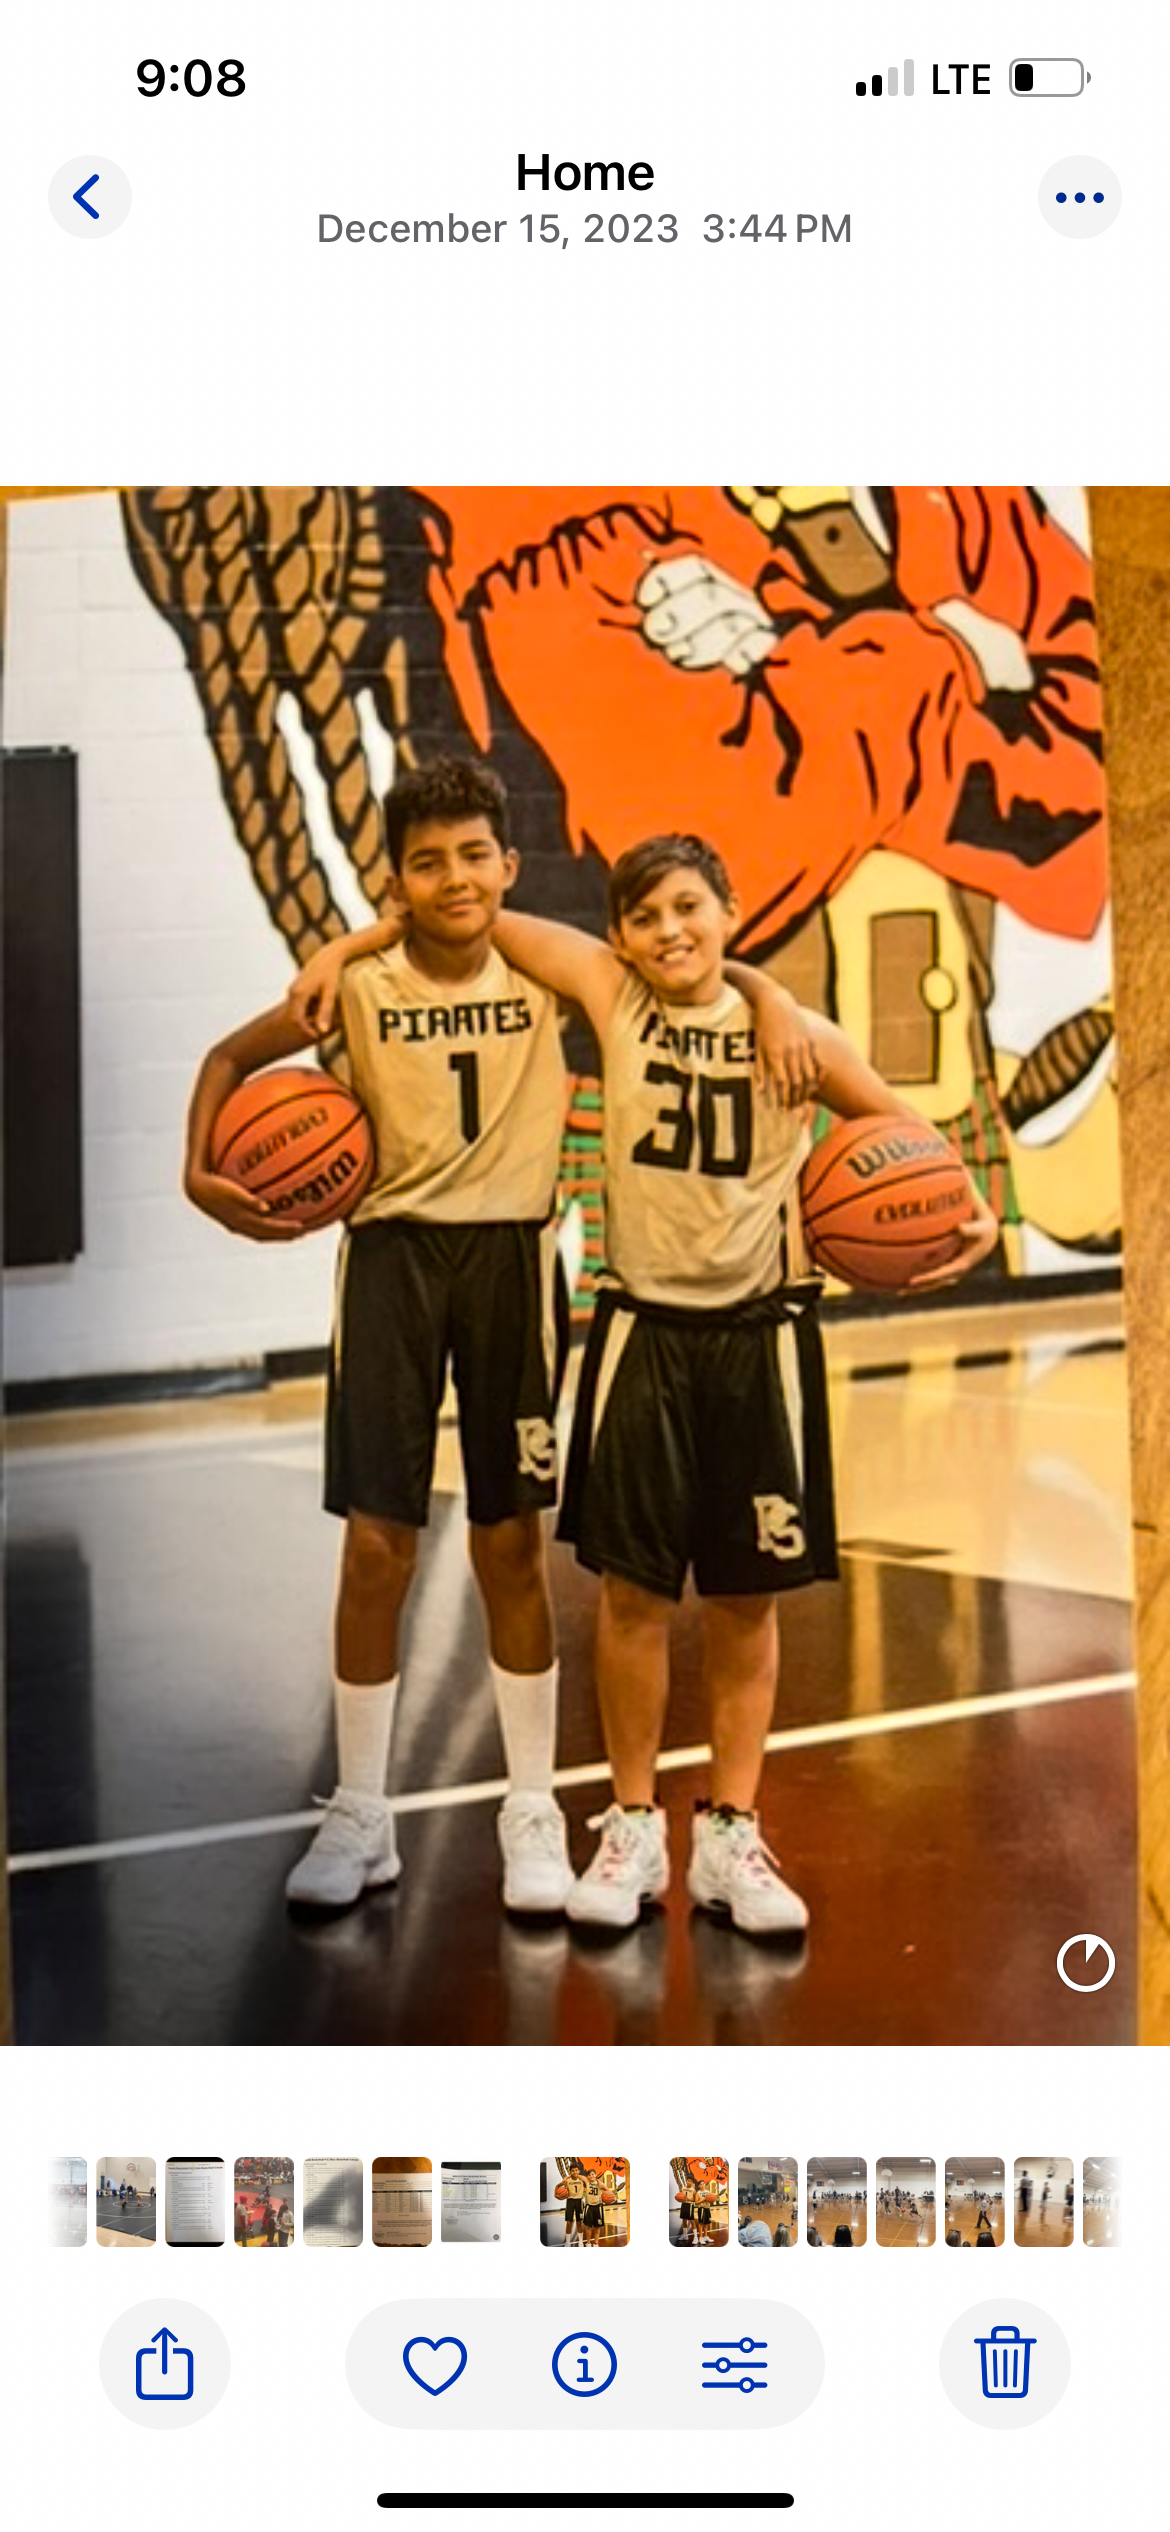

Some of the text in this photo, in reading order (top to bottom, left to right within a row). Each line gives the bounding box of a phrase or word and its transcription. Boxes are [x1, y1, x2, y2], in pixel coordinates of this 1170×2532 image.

[136, 58, 246, 98] 9:08
[932, 63, 991, 95] LTE
[517, 153, 655, 192] Home
[318, 213, 851, 250] December 15, 2023 3:44 PM
[378, 998, 532, 1042] PIRATES
[449, 1051, 480, 1145] 1
[632, 1060, 753, 1178] 30
